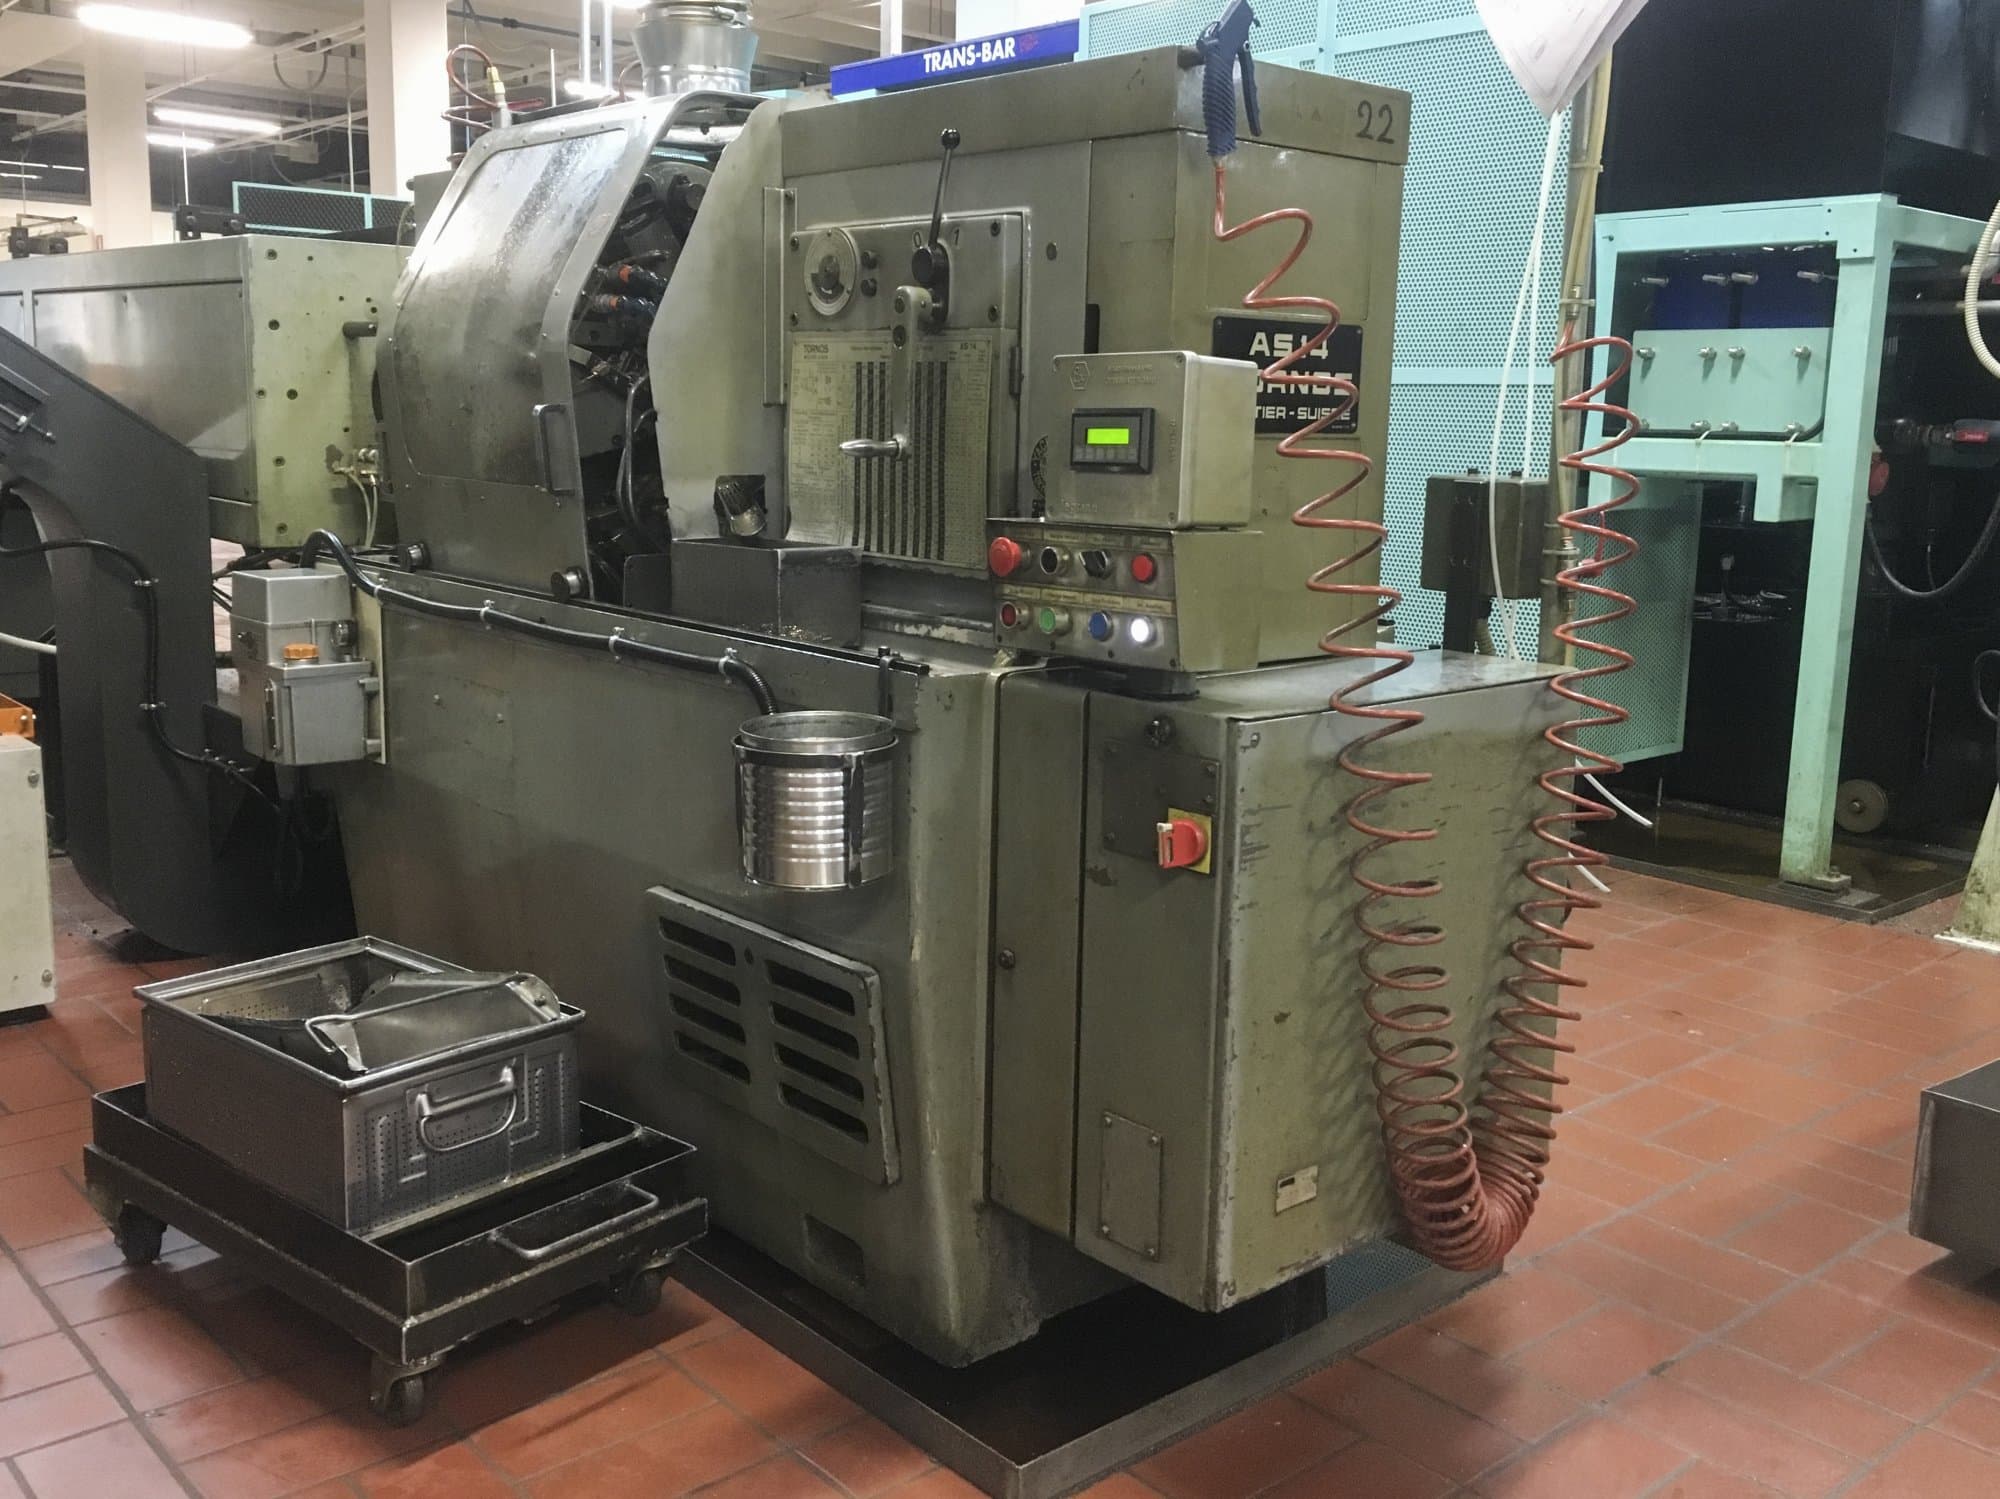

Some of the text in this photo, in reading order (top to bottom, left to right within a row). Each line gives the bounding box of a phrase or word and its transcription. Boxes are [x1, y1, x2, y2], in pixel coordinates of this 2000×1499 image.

[923, 36, 1016, 73] TRANS-BAR
[1355, 99, 1395, 145] 22
[913, 231, 922, 248] 0
